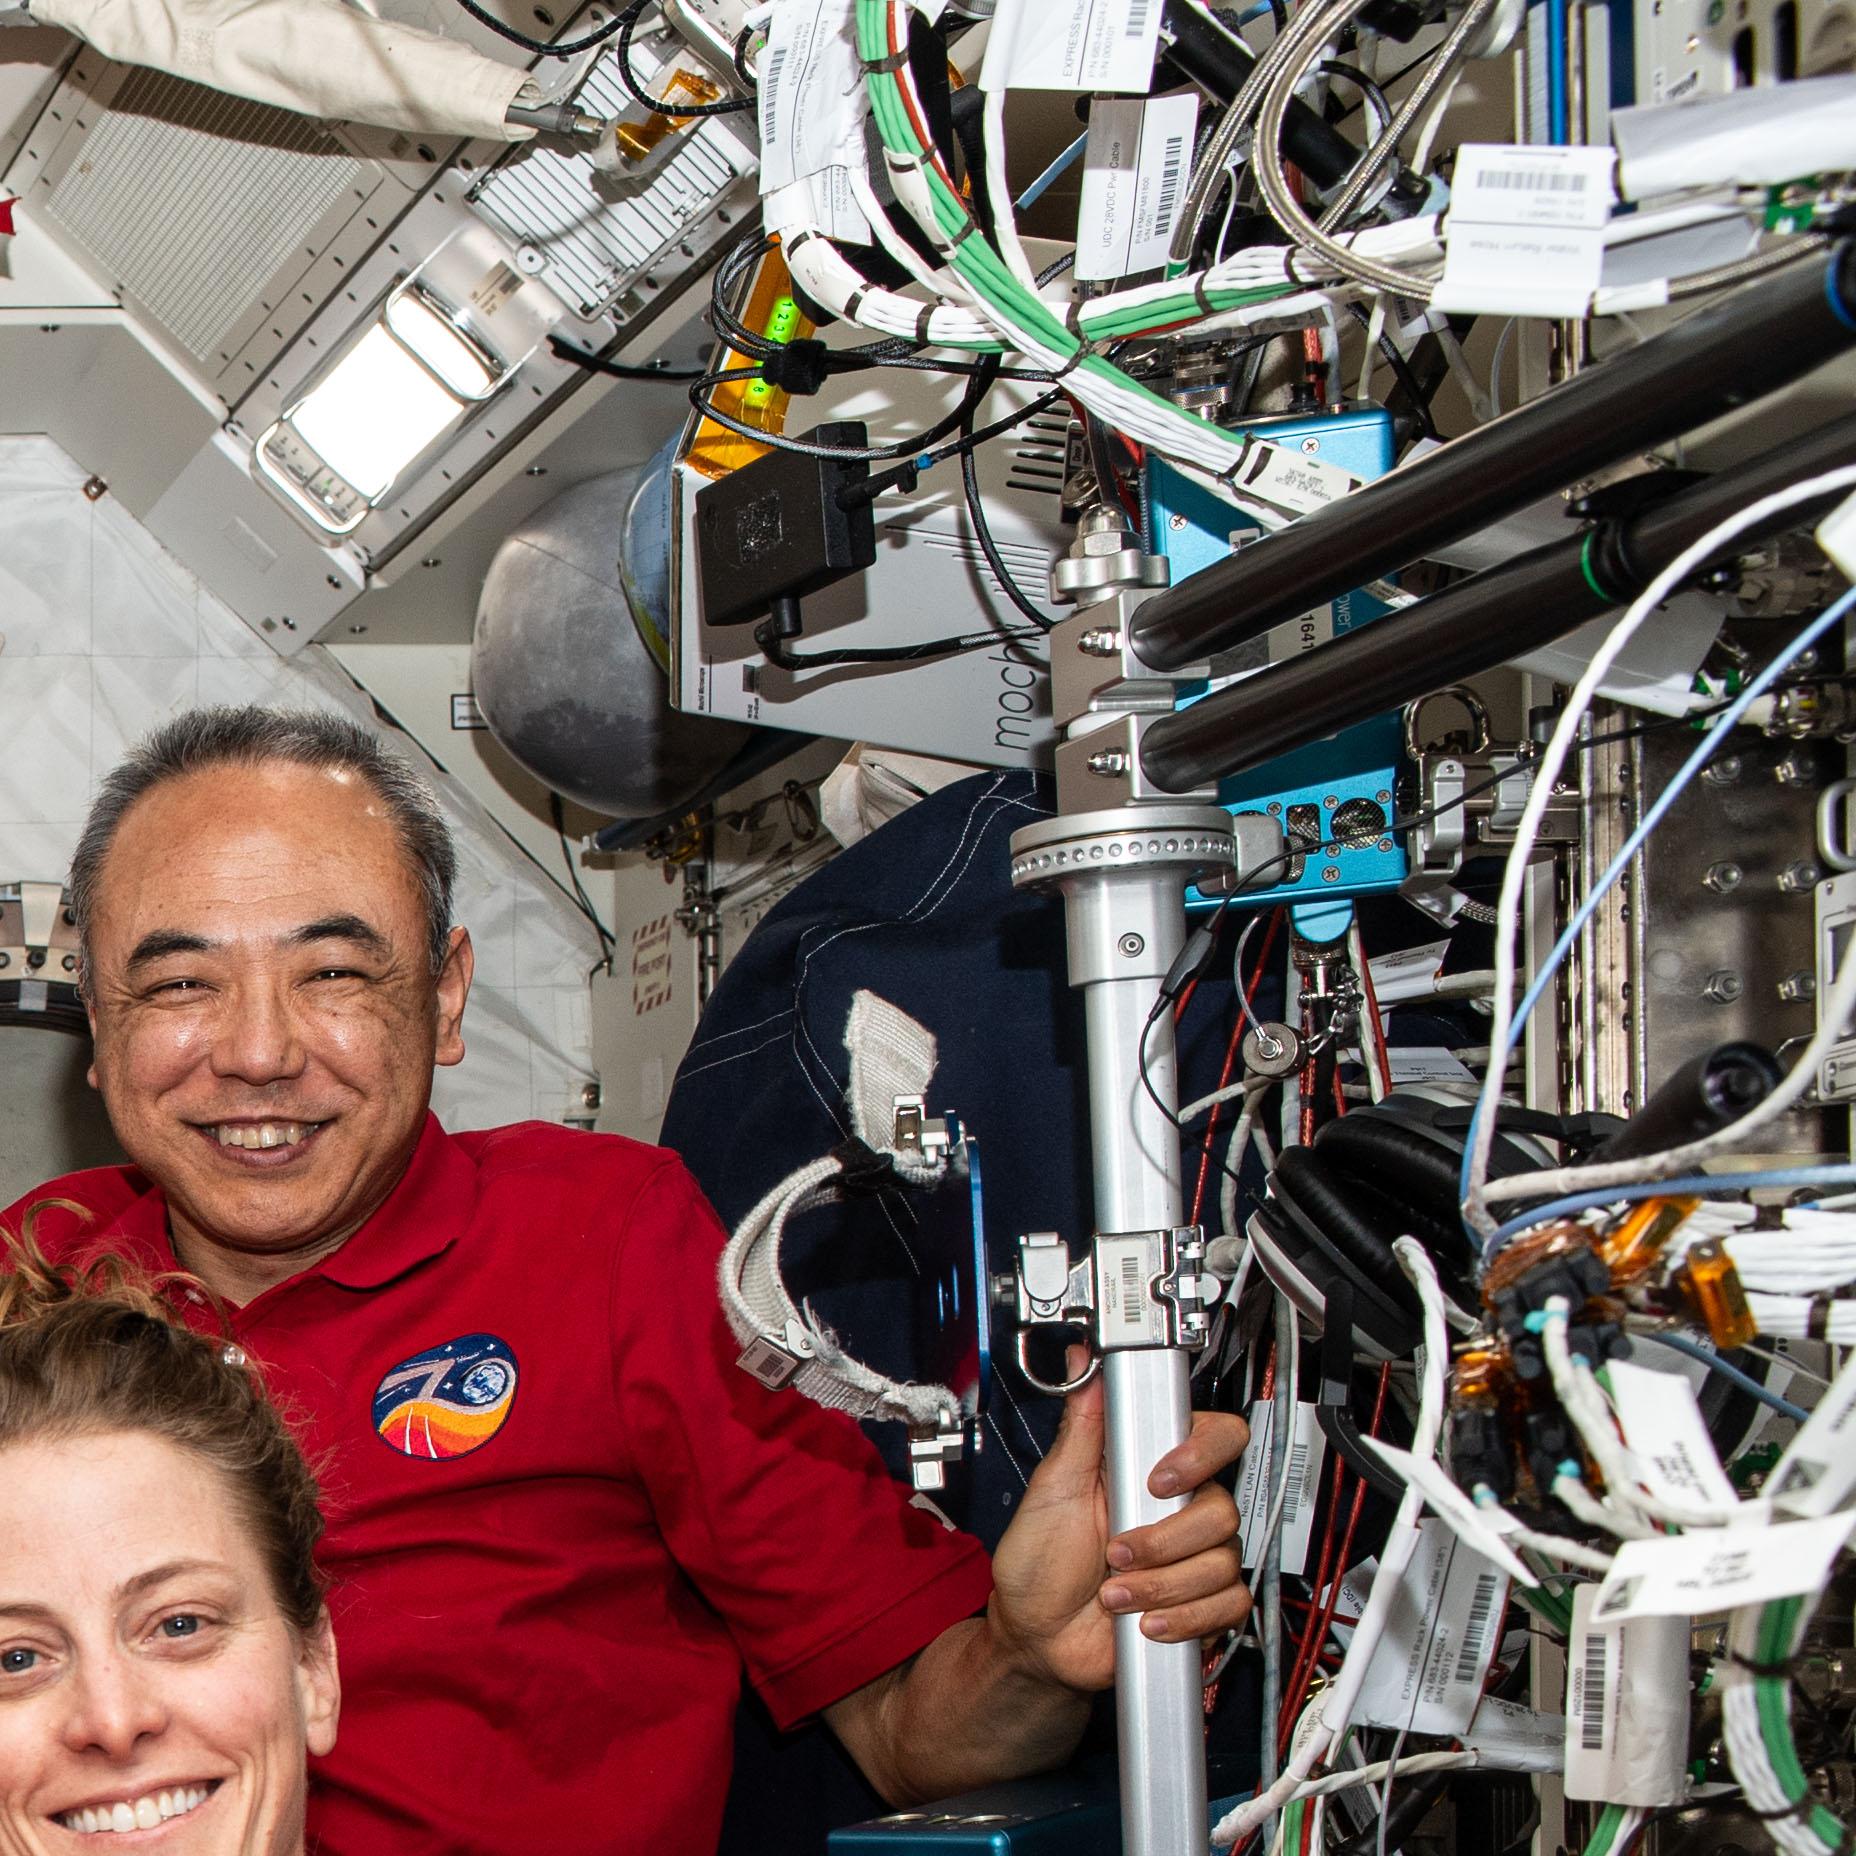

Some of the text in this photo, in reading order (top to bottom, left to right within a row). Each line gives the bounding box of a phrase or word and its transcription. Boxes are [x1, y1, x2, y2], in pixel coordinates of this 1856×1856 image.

[1062, 22, 1081, 76] EXPRESS
[1109, 141, 1121, 168] Cable
[1240, 1445, 1258, 1516] NeST LAN Cable
[1401, 1569, 1440, 1700] EXPRESS Rack Power Cable
